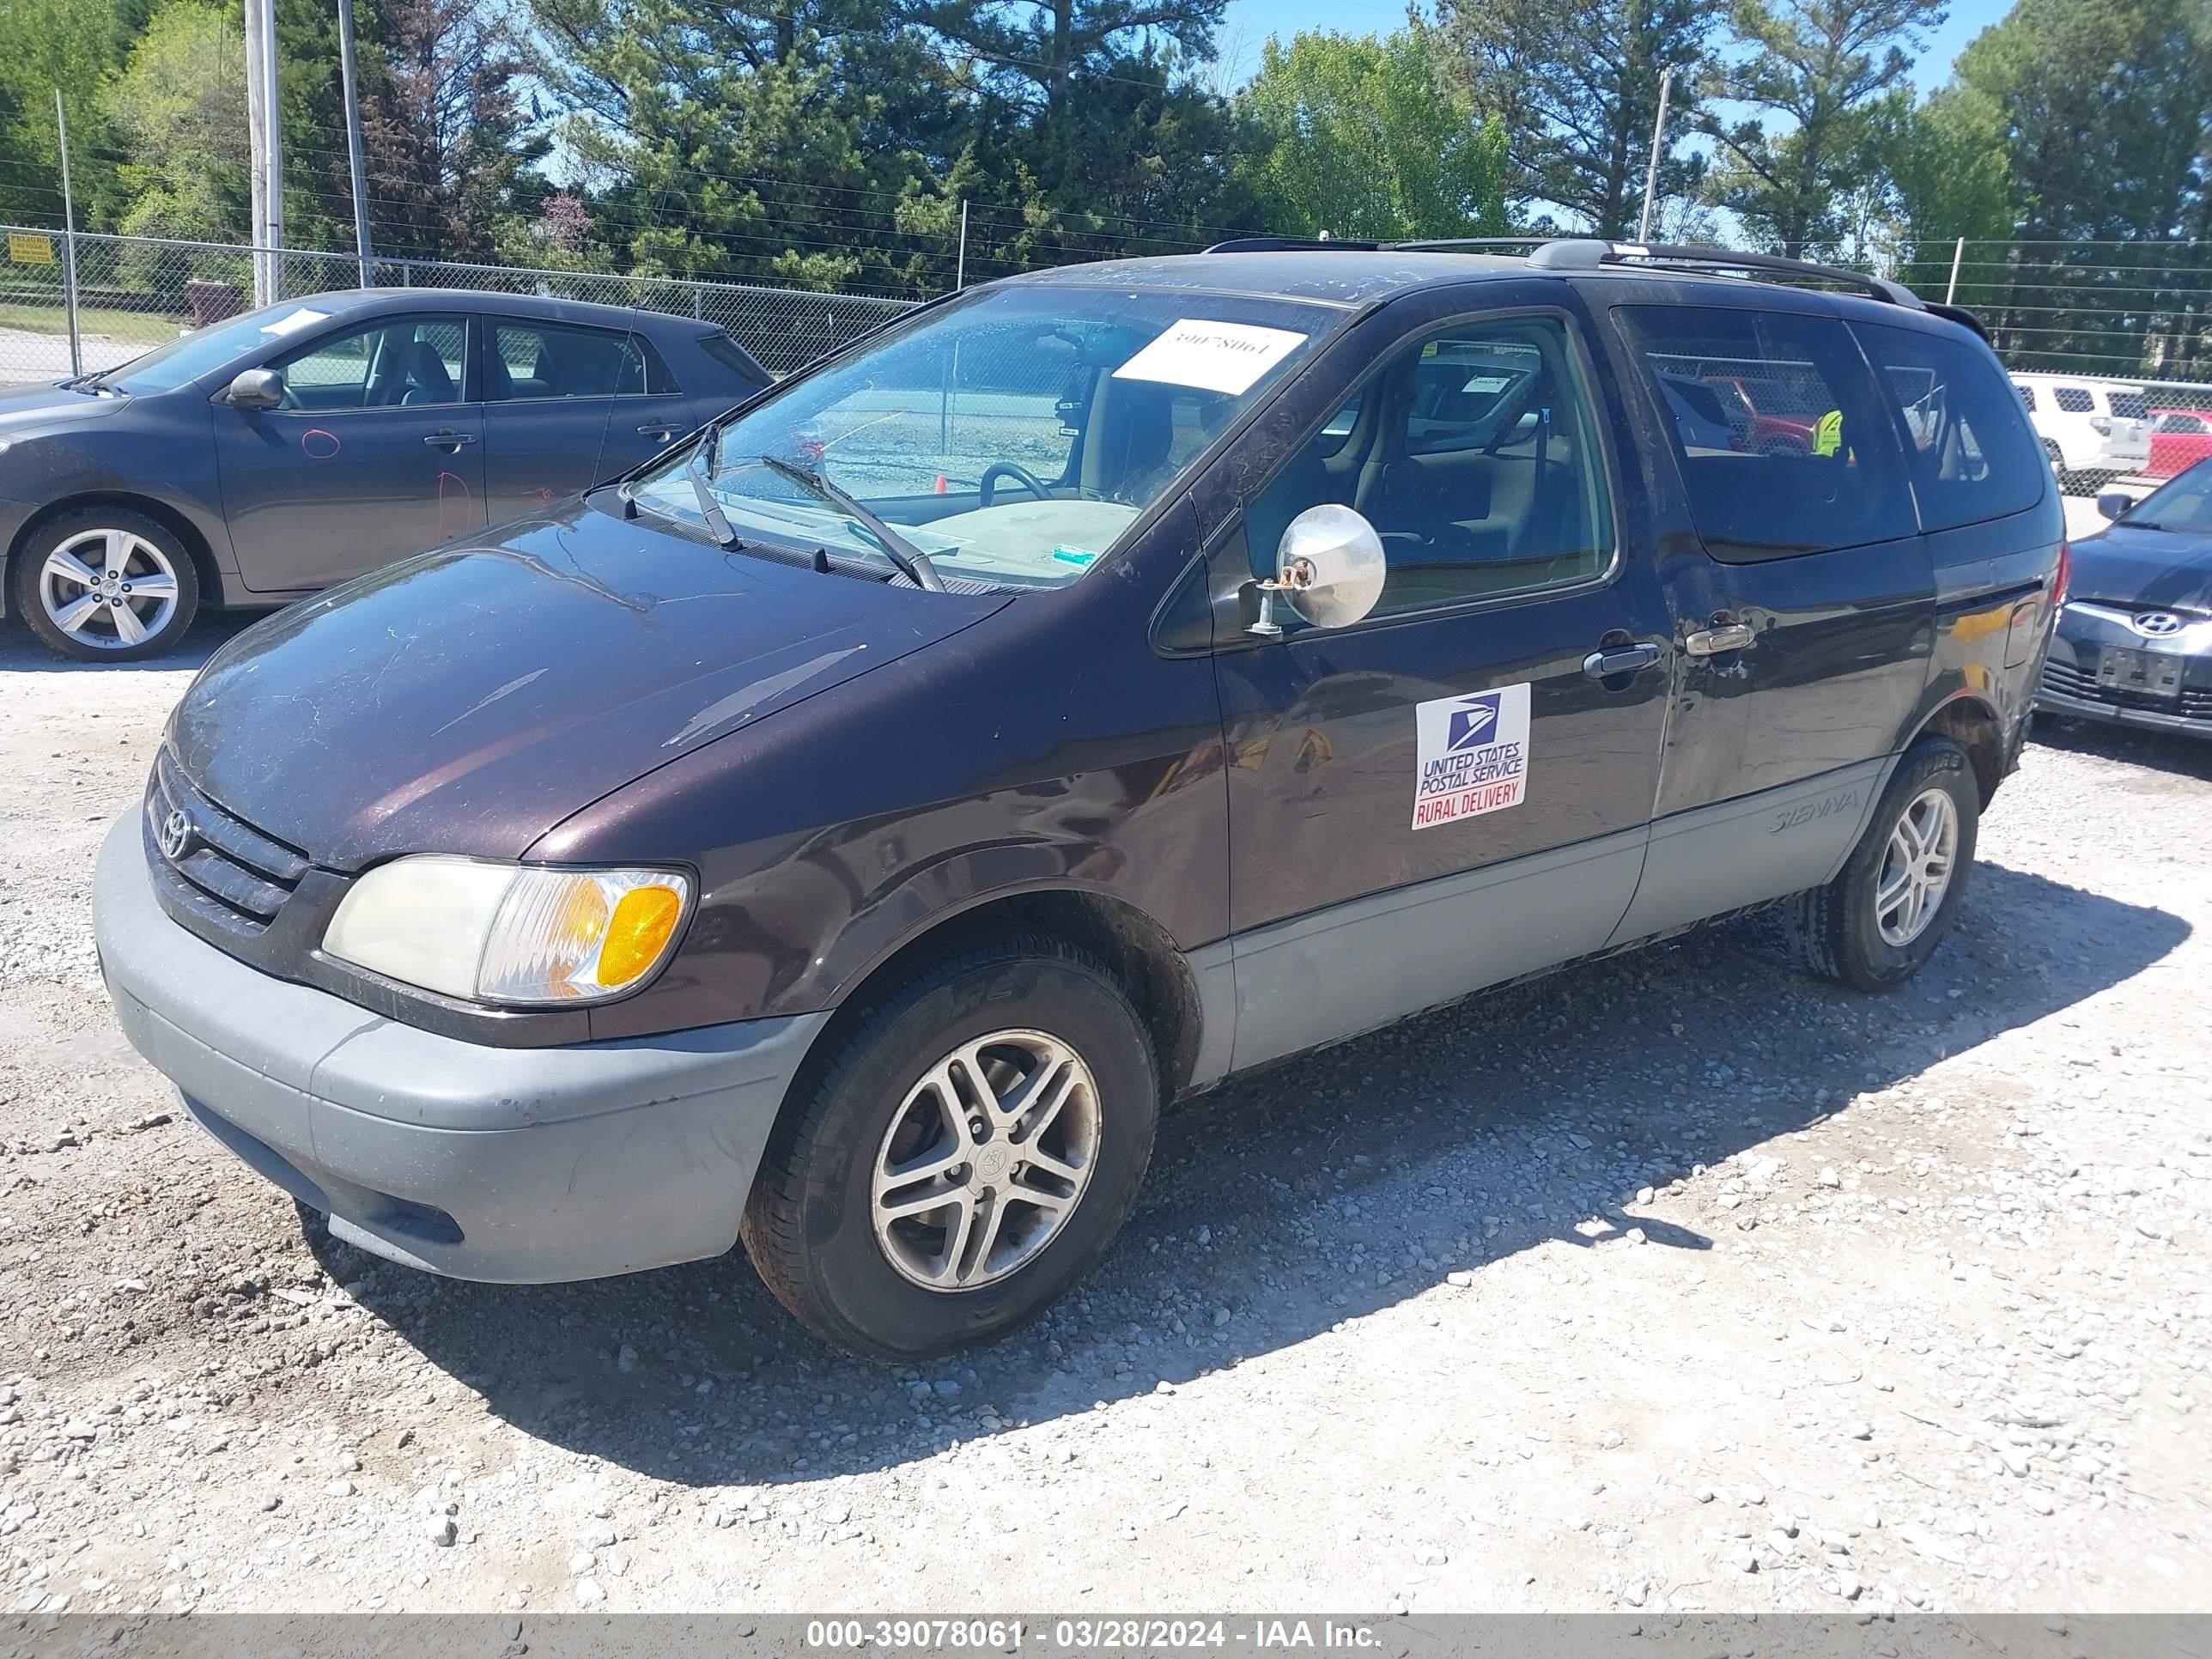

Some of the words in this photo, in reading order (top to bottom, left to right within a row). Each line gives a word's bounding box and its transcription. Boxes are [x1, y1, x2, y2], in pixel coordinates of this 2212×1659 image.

[1419, 770, 1469, 796] POSTAL
[1471, 758, 1523, 783] SERVICE
[1424, 752, 1474, 777] UNITED
[1476, 742, 1520, 766] STATES
[1416, 797, 1457, 825] RURAL
[1462, 781, 1519, 814] DELIVERY
[1767, 791, 1858, 833] SIENNA
